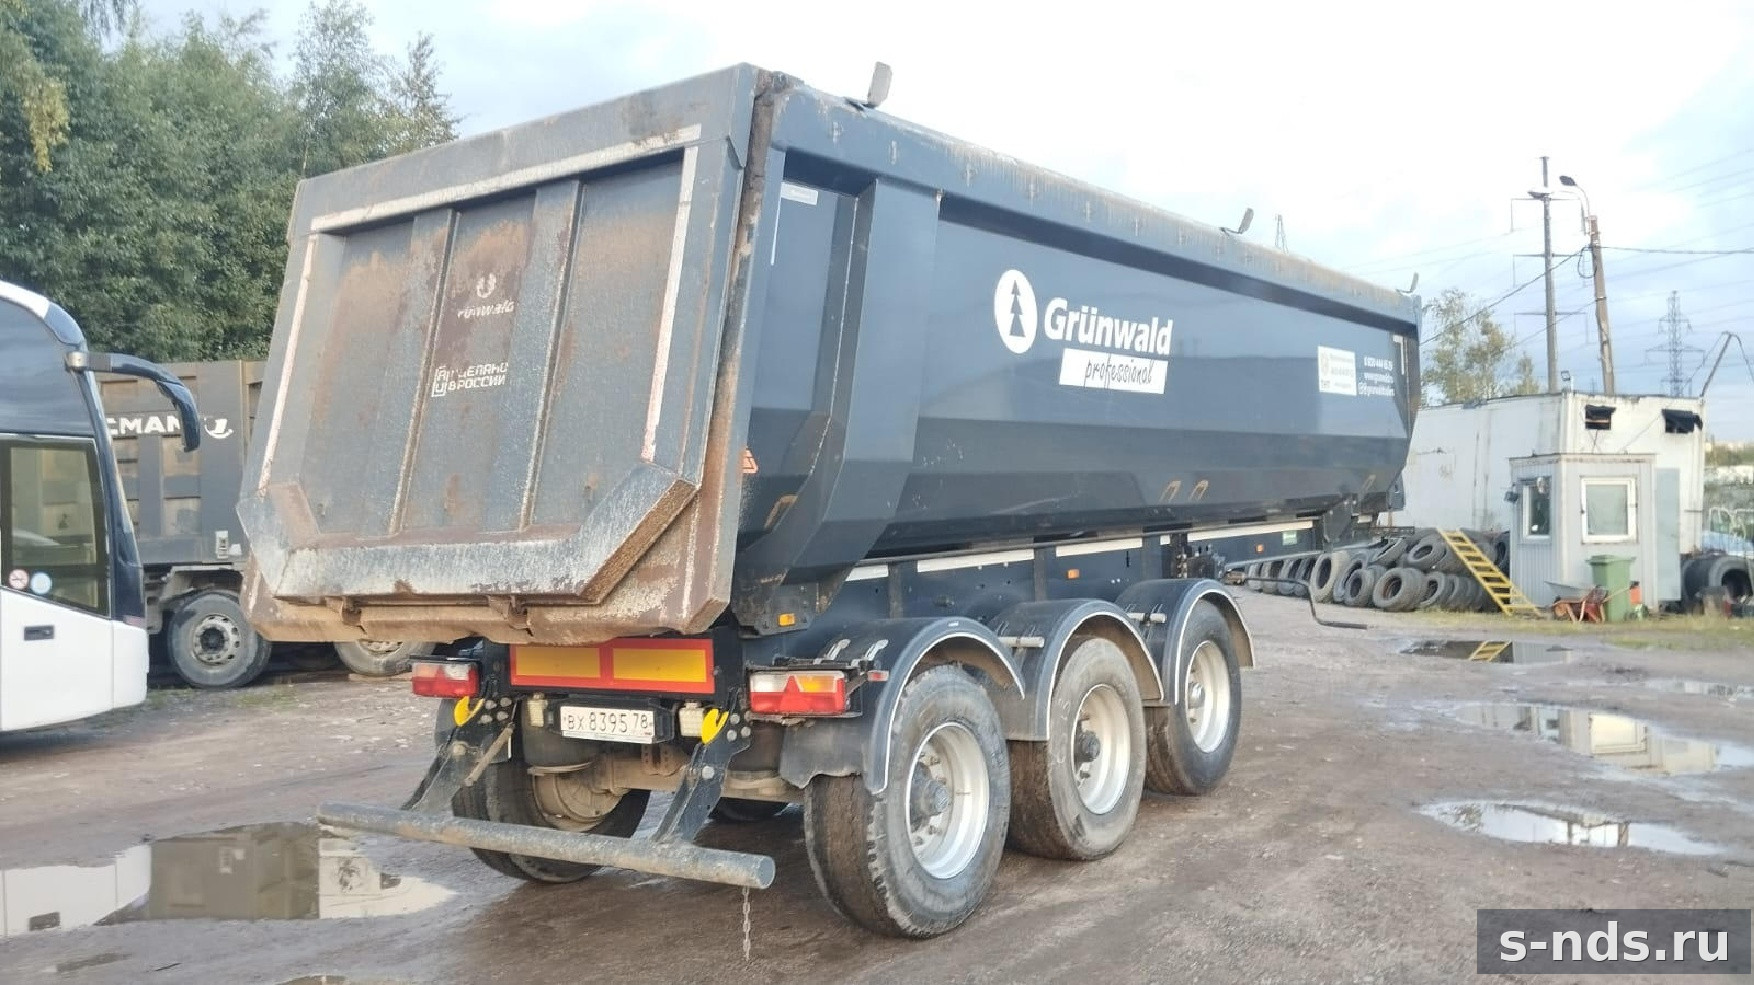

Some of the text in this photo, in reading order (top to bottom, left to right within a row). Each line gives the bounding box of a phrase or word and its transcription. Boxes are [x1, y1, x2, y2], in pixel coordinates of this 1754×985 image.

[1044, 297, 1173, 355] Grünwald
[457, 375, 506, 390] РОССИИ
[1083, 353, 1155, 390] professional
[589, 711, 628, 733] 8395
[632, 712, 648, 729] 78
